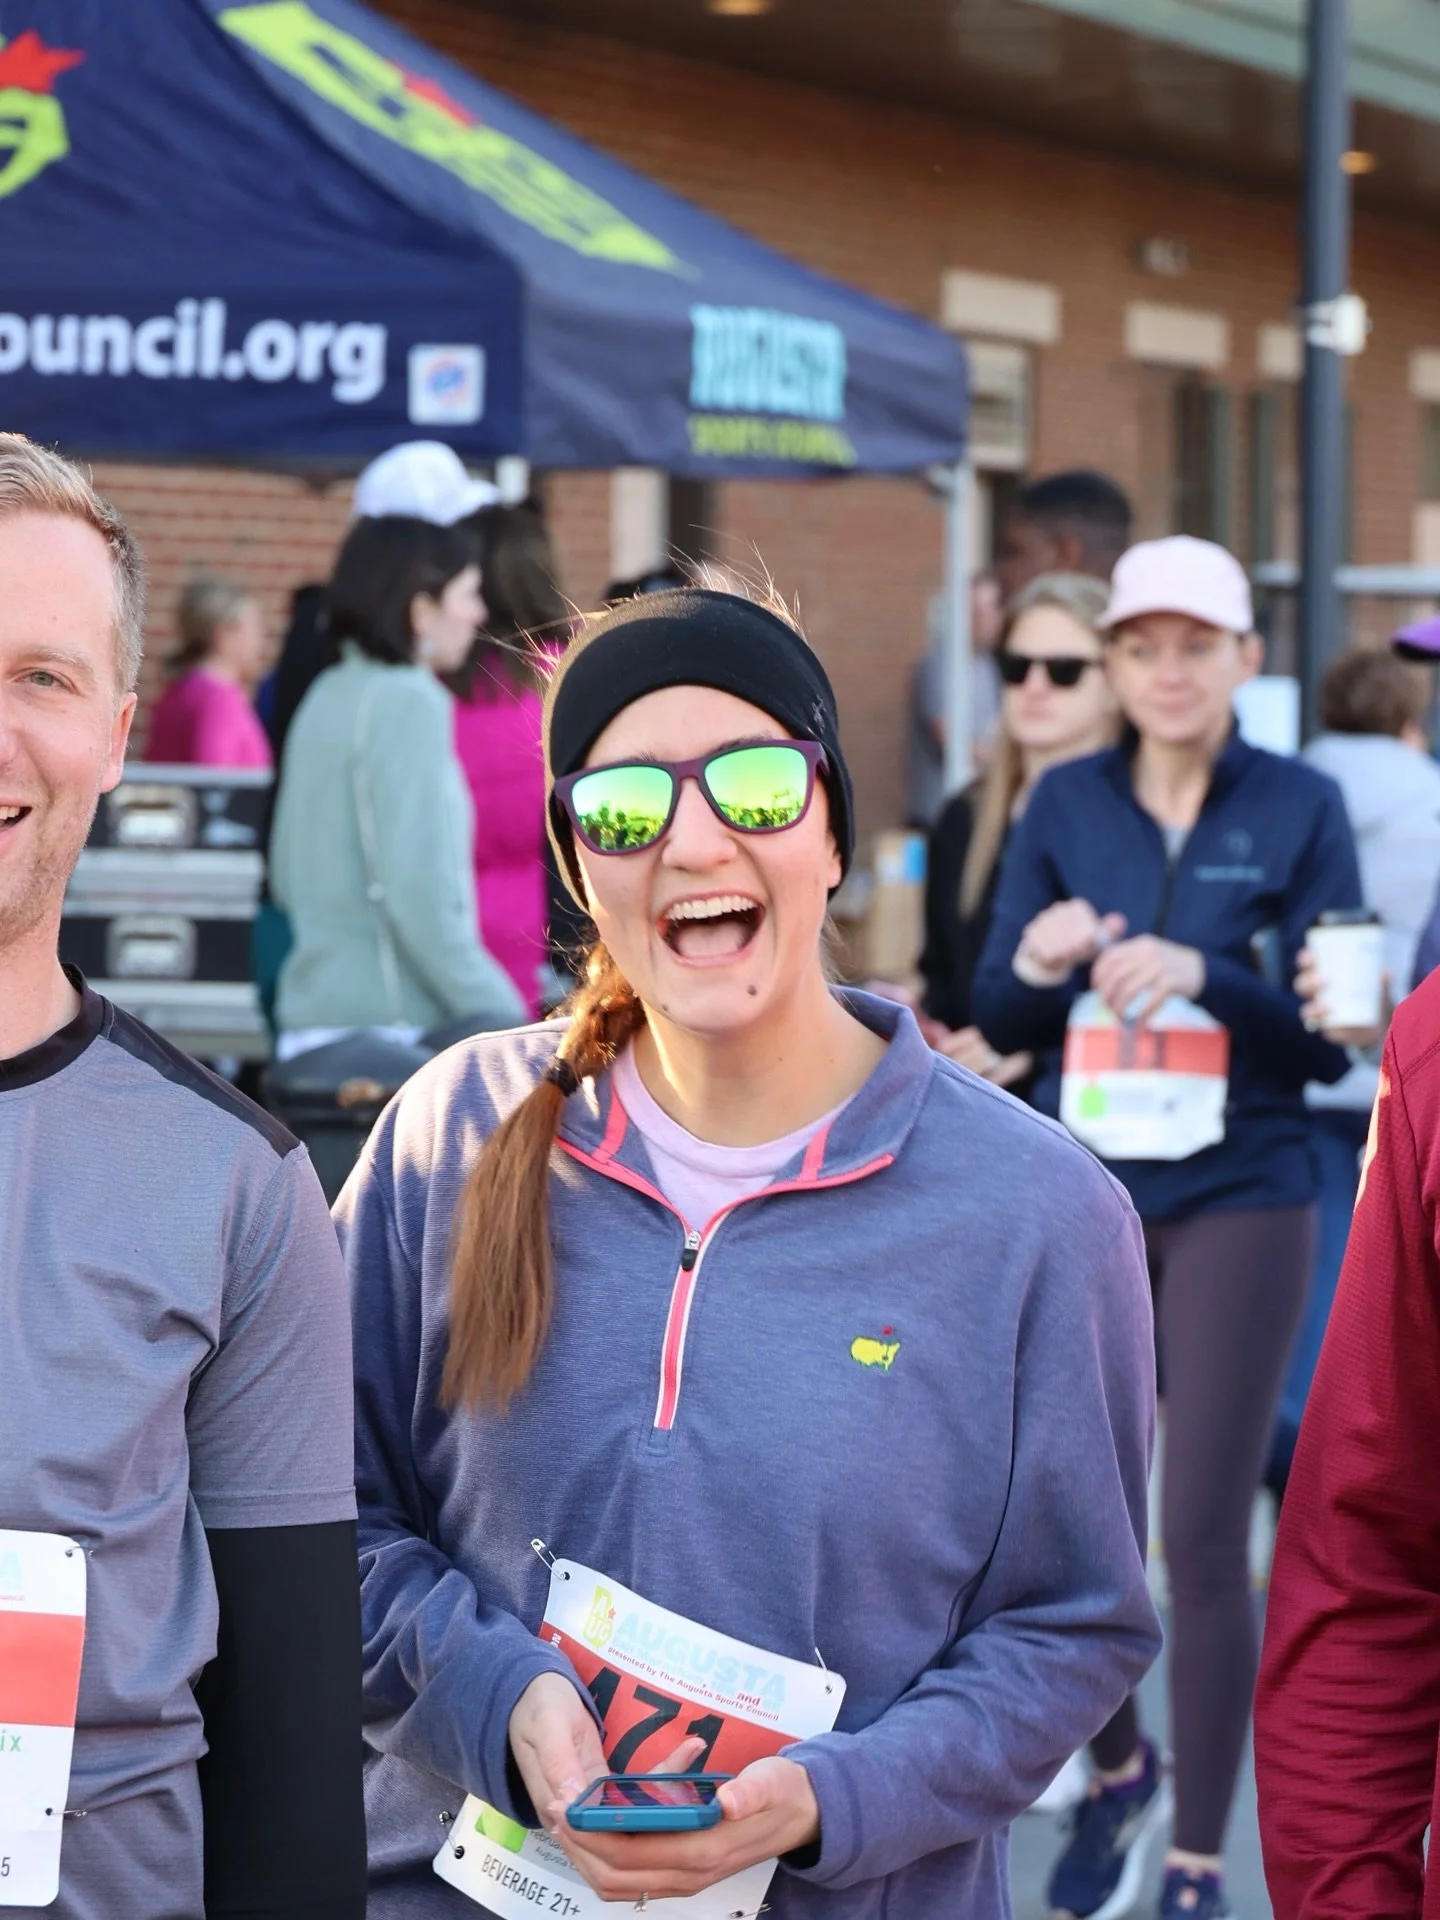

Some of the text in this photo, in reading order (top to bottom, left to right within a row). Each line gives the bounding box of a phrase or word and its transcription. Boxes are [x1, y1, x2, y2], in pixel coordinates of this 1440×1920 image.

[0, 298, 387, 404] ouncil.org
[607, 1646, 780, 1721] presented by The Augusta Sports Council
[612, 1612, 786, 1702] AUGUSTA
[737, 1692, 761, 1706] and
[482, 1854, 581, 1917] BEVERAGE 21+
